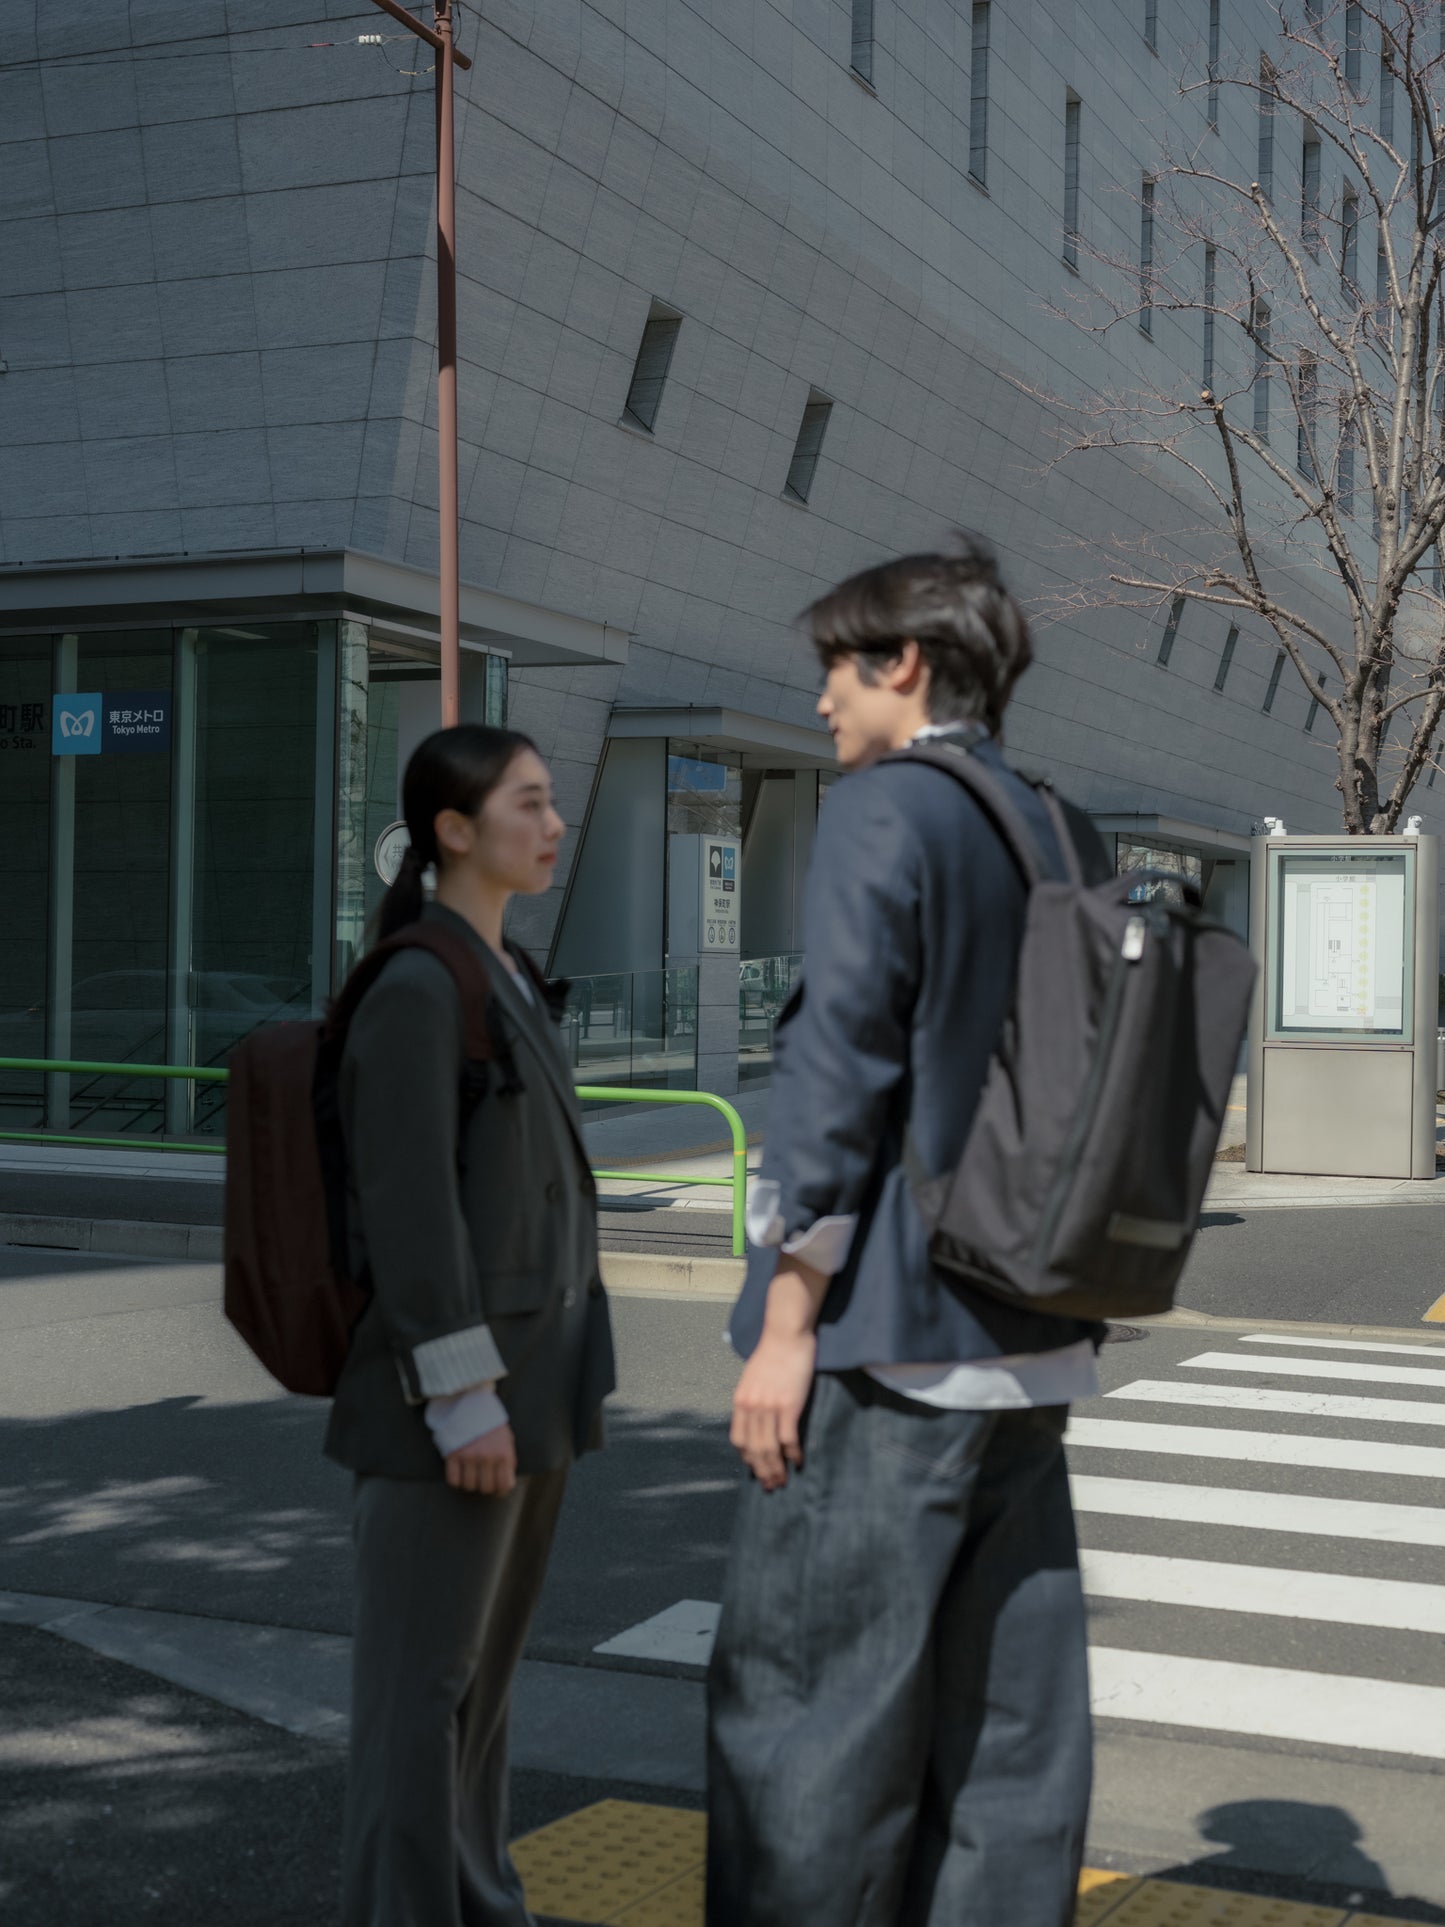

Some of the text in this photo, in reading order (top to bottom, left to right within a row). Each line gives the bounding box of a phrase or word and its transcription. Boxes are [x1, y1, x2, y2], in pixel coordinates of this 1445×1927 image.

[109, 709, 164, 724] 東京メトロ
[112, 724, 160, 736] Tokyo Metro
[12, 735, 37, 749] Sta.
